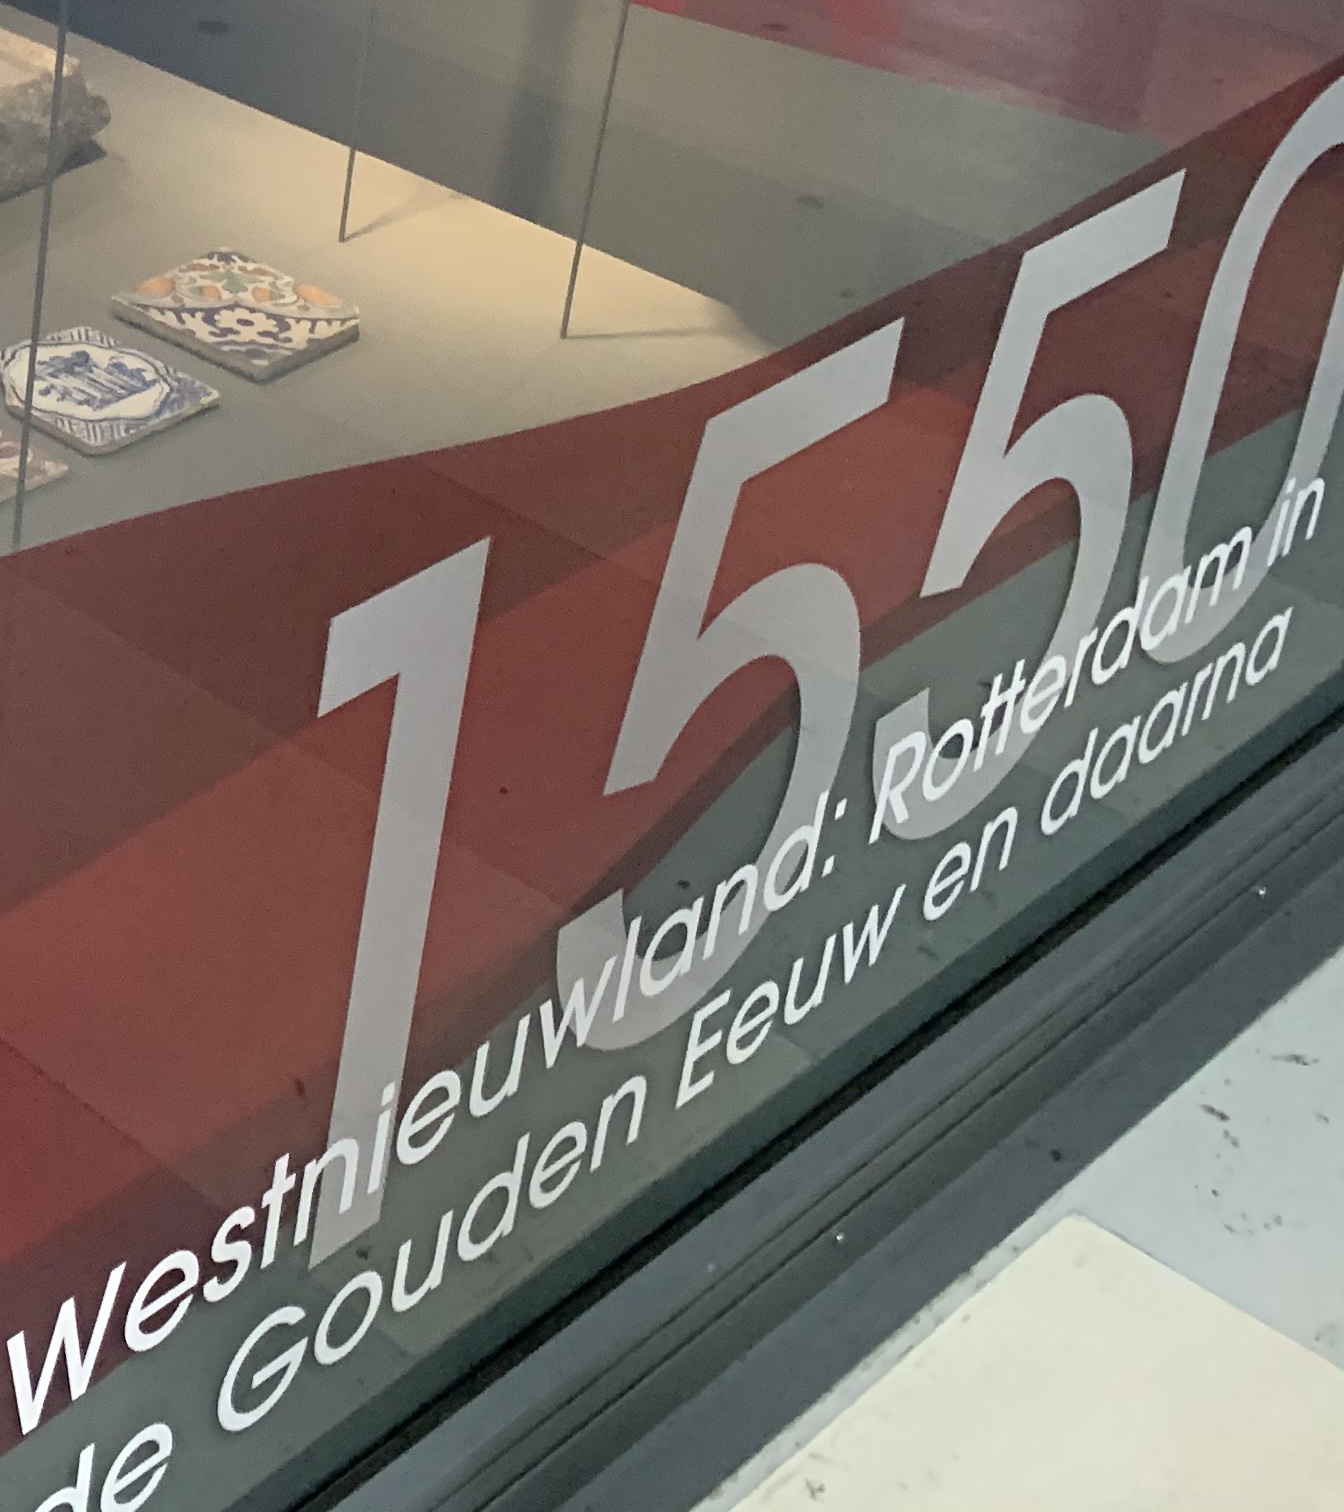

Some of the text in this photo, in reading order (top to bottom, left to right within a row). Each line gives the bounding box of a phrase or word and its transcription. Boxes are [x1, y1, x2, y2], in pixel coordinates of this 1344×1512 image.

[6, 476, 1325, 1435] Westnieuwland: Rotterdam in
[32, 606, 1293, 1512] de Gouden Eeuw en daarna
[309, 74, 1344, 1274] 1550
